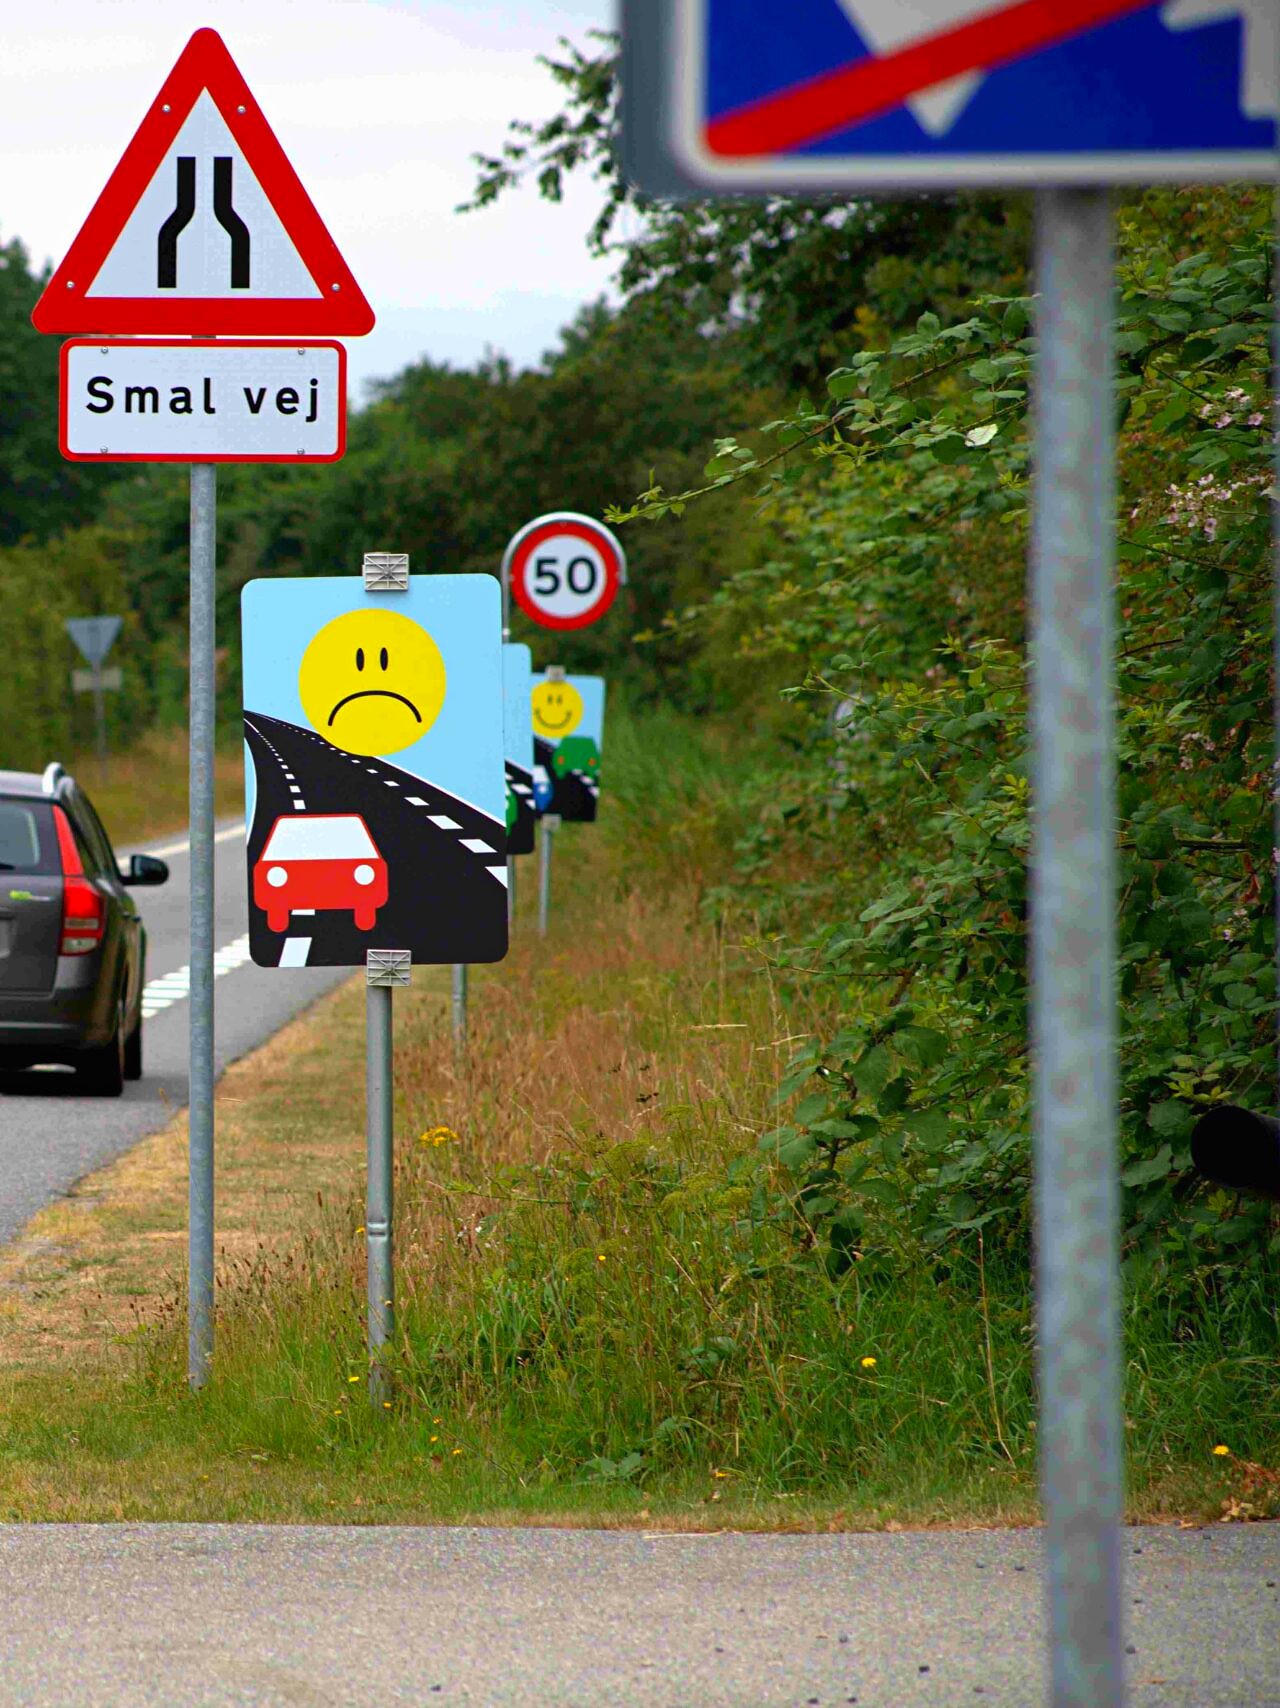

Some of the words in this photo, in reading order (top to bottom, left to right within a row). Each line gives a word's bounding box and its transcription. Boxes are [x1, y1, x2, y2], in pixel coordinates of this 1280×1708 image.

[86, 375, 216, 415] Smal
[243, 378, 319, 423] vej
[534, 556, 597, 595] 50
